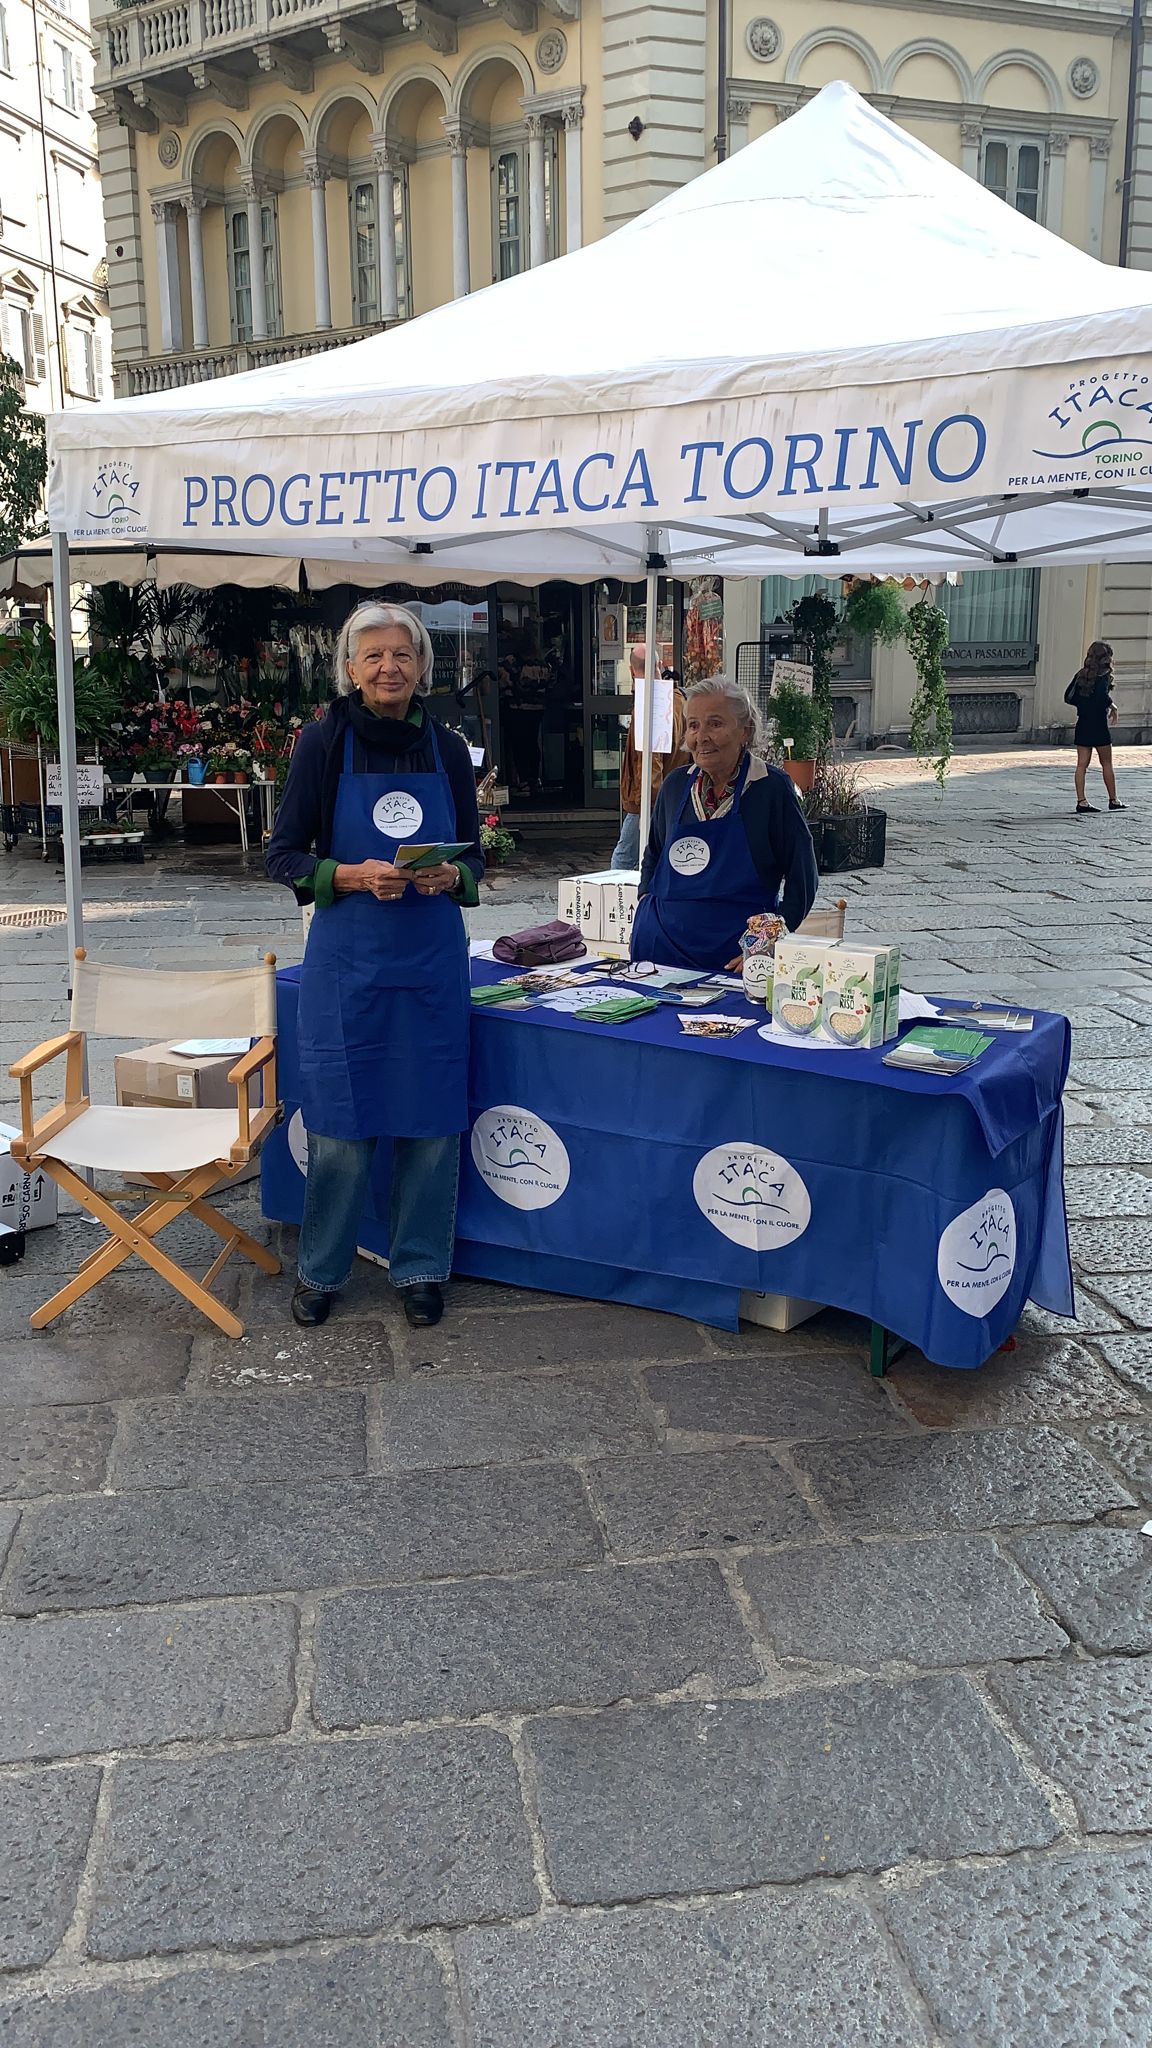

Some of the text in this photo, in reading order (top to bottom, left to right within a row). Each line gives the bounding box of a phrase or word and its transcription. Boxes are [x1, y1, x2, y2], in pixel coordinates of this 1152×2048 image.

[1069, 373, 1149, 390] PROGETTO
[1095, 452, 1143, 464] TORINO
[182, 414, 987, 527] PROGETTO ITACA TORINO
[1008, 476, 1028, 486] PER
[1031, 475, 1045, 485] LA
[1047, 471, 1091, 483] MENTE,
[1094, 468, 1124, 480] CON
[1127, 467, 1137, 477] IL
[92, 470, 140, 498] ITACA
[940, 648, 1027, 659] BANCA PASSADORE
[381, 799, 415, 814] ITACA
[676, 843, 705, 855] ITACA
[748, 963, 774, 973] ITAC
[791, 990, 807, 1001] RISO
[839, 998, 855, 1010] RISO
[489, 1125, 547, 1158] ITACA
[728, 1154, 775, 1172] PROGETTO
[718, 1162, 785, 1197] ITACA
[707, 1208, 719, 1216] PER
[720, 1209, 728, 1217] LA
[969, 1214, 1010, 1249] ITACA
[946, 1280, 960, 1288] PER
